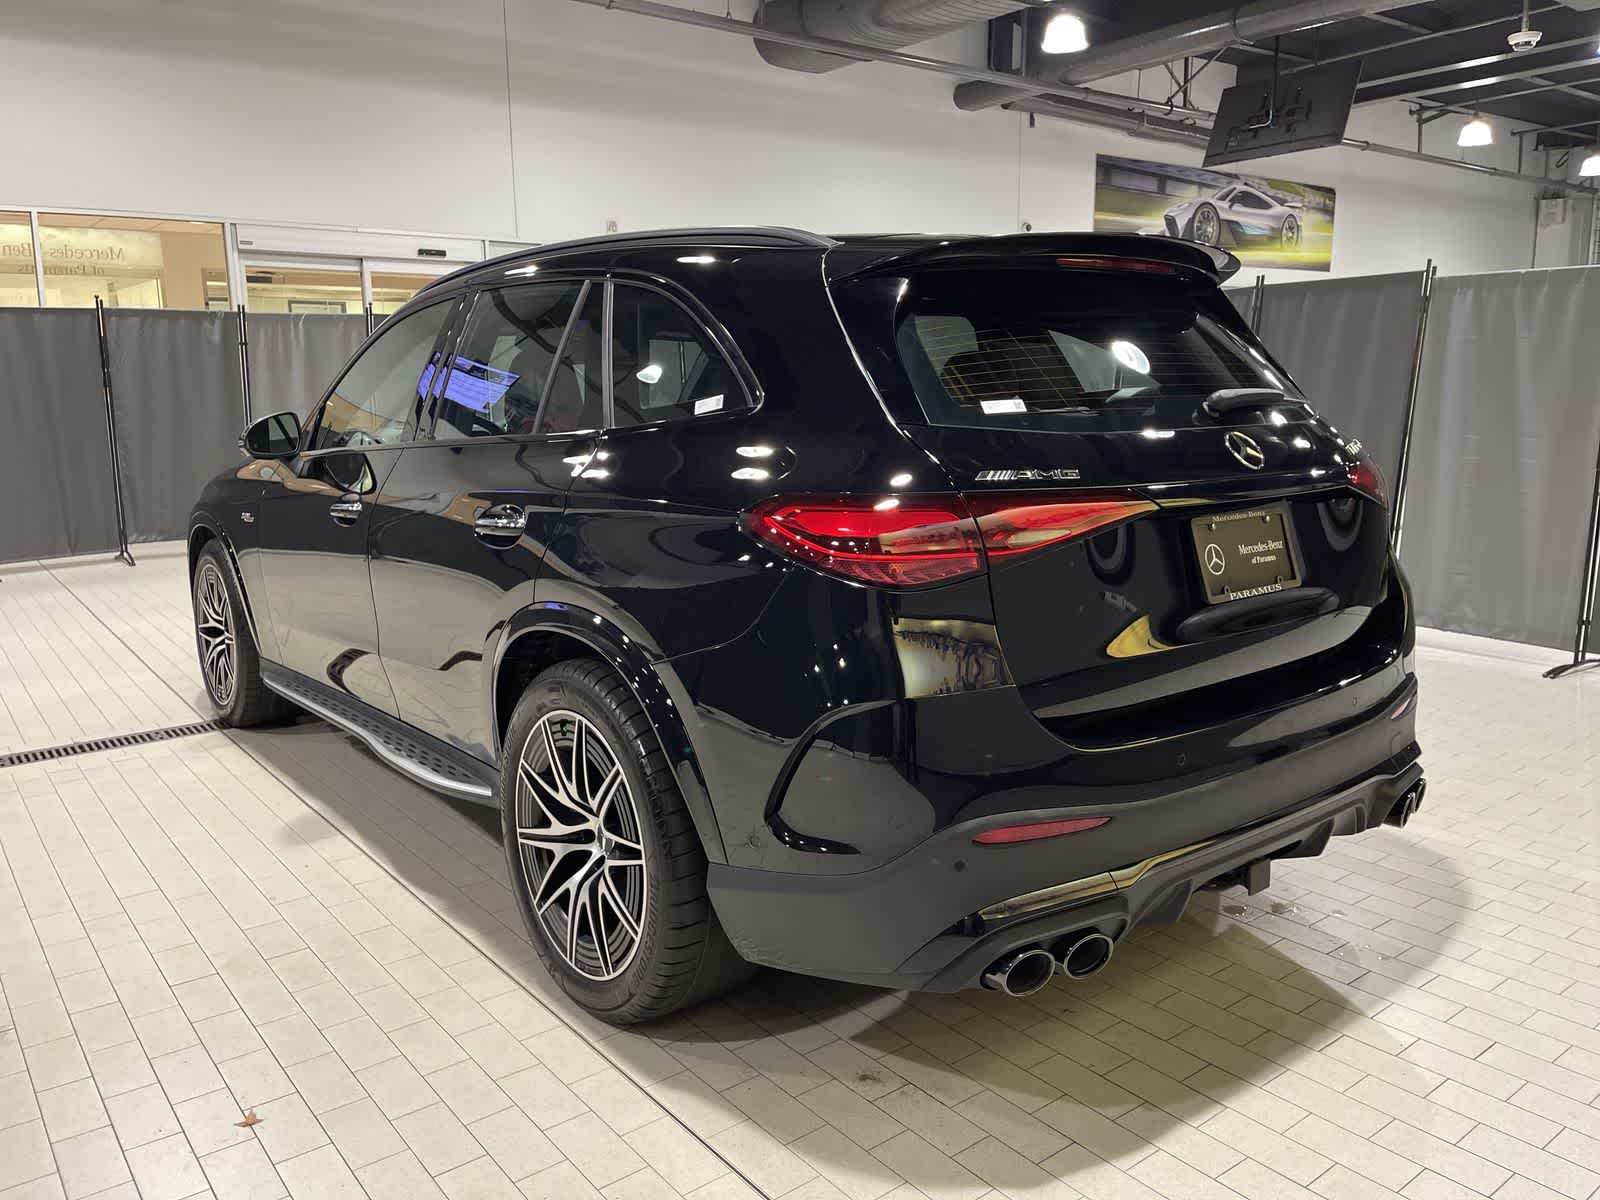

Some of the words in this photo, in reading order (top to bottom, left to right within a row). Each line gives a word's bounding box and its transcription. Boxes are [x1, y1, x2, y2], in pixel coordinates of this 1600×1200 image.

[1012, 469, 1081, 480] AMG
[1238, 540, 1283, 555] Mercedes-Benz
[1230, 583, 1282, 600] PARAMUS
